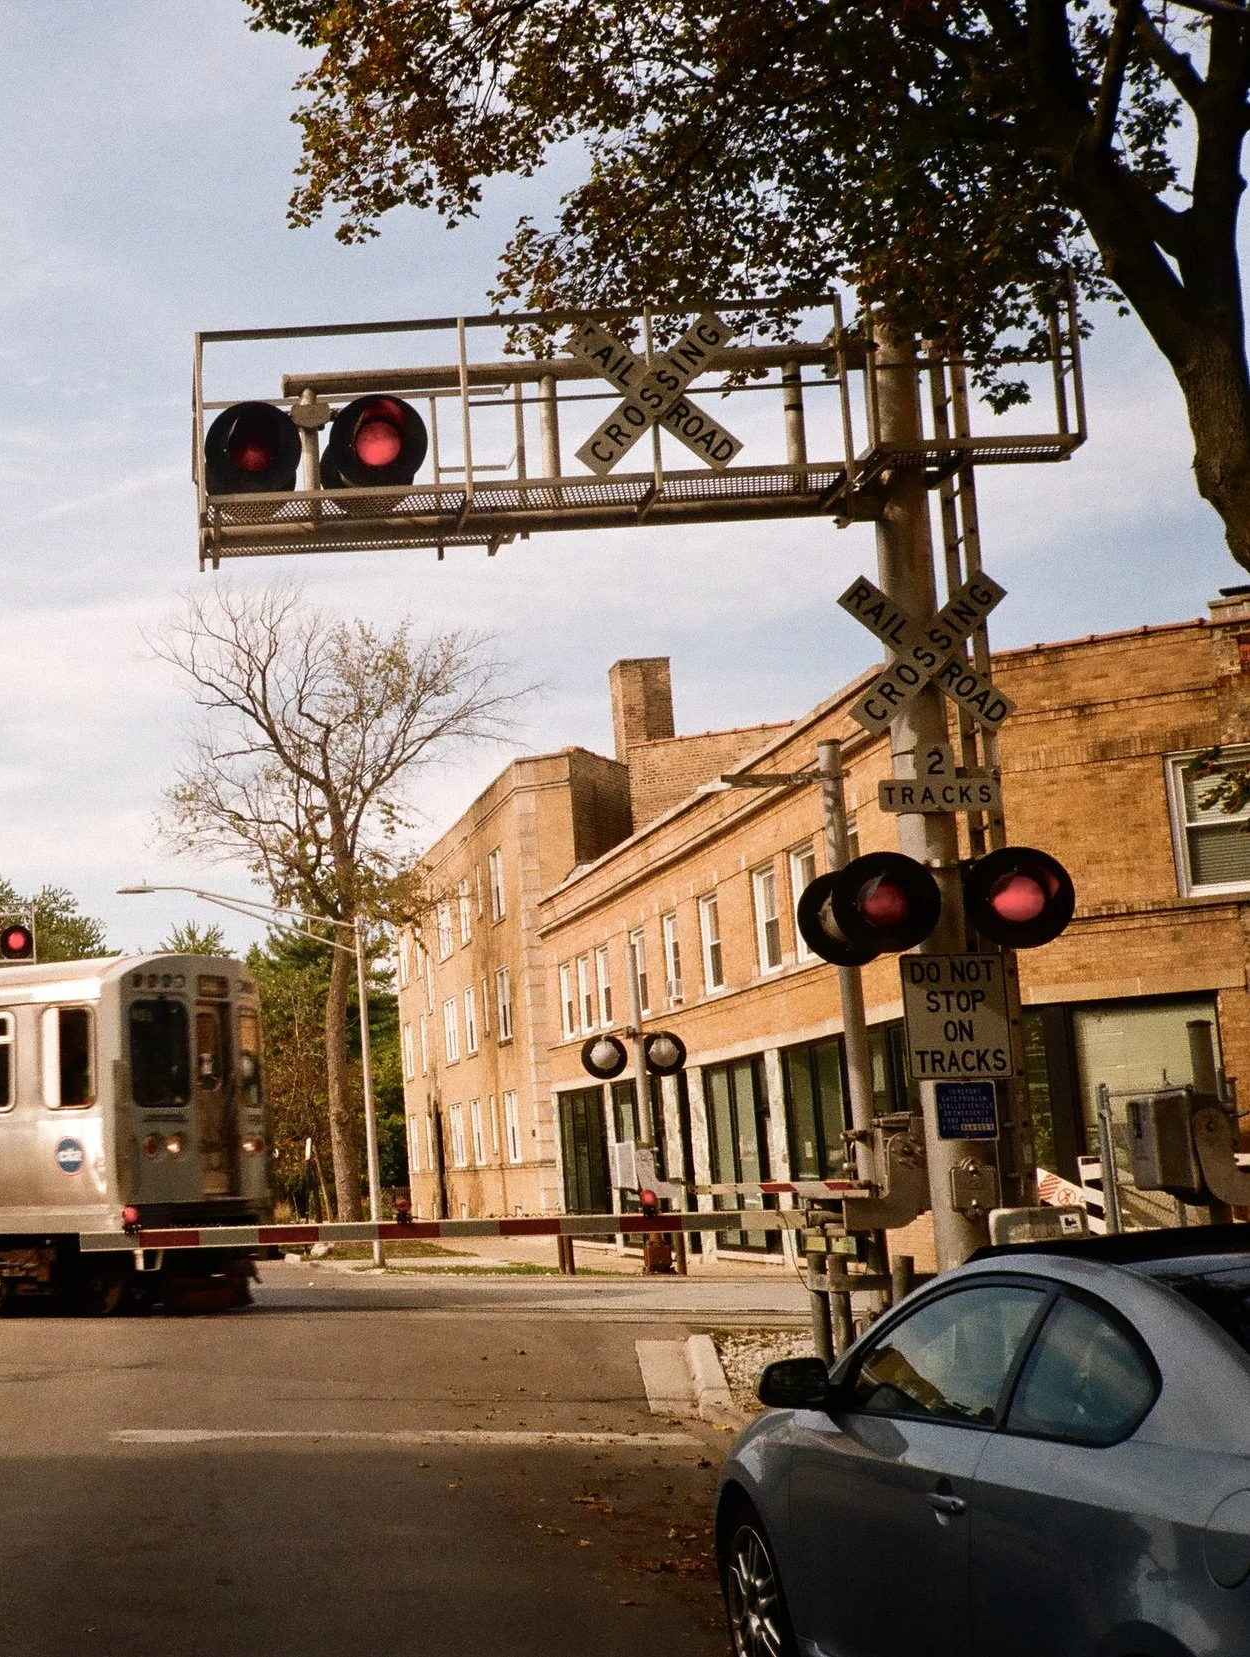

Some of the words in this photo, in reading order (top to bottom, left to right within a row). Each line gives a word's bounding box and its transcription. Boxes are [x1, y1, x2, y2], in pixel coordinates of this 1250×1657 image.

[590, 324, 721, 463] CROSSING
[665, 402, 734, 462] ROAD
[846, 583, 907, 645] RAIL
[939, 660, 1008, 723] ROAD
[863, 583, 993, 722] CROSSING
[927, 750, 945, 775] 2
[884, 785, 992, 805] TRACKS
[909, 961, 941, 984] DO
[950, 960, 994, 983] NOT
[926, 989, 985, 1013] STOP
[943, 1020, 974, 1042] ON
[915, 1048, 1007, 1073] TRACKS
[938, 1102, 966, 1110] STALLED
[967, 1102, 994, 1110] VEHICLE
[953, 1109, 989, 1117] EMERGENCY
